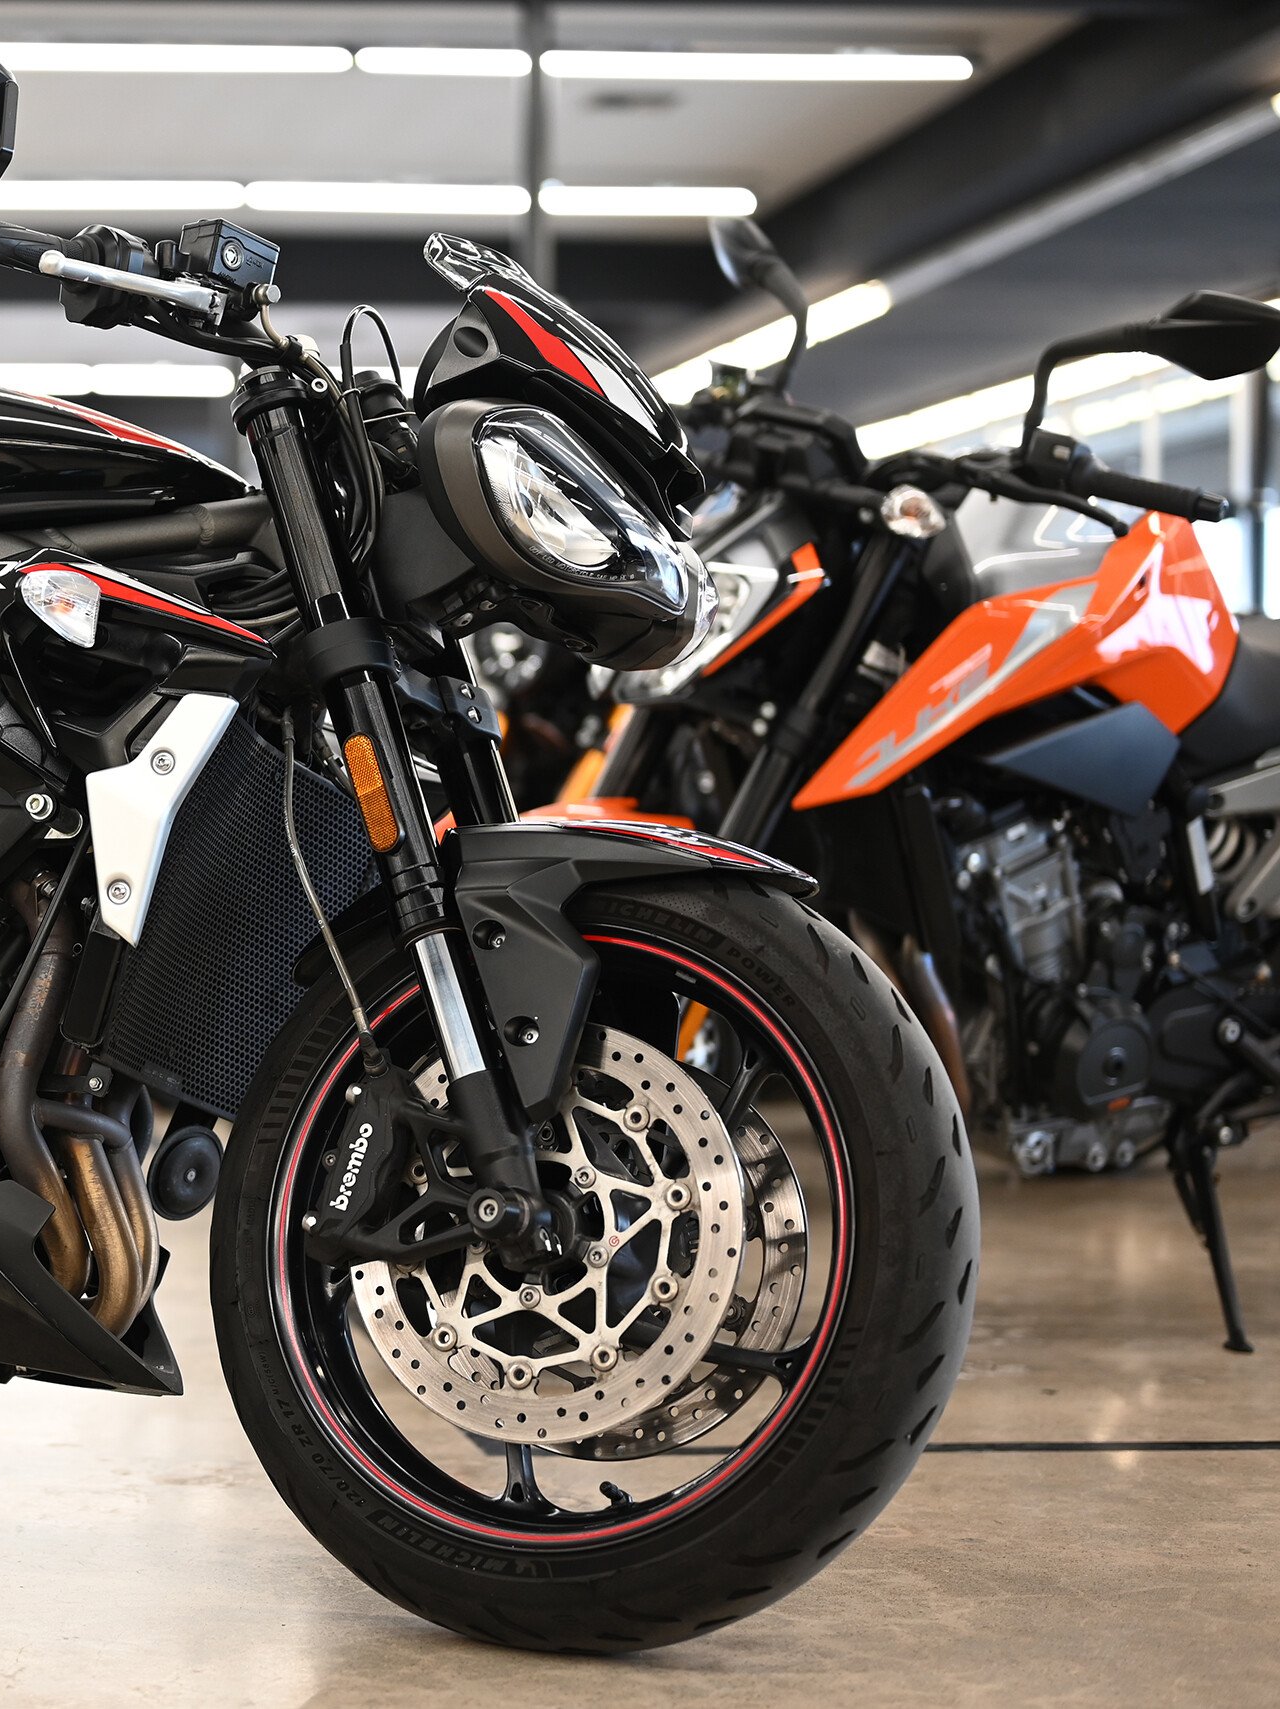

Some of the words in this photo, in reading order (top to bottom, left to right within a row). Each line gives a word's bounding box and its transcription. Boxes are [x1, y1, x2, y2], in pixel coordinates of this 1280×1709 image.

[726, 944, 797, 1009] POWER
[329, 1122, 373, 1212] brembo
[276, 1398, 296, 1420] 17
[290, 1423, 315, 1449] ZR
[311, 1451, 365, 1508] 120/70
[376, 1513, 509, 1573] MICHELIN
